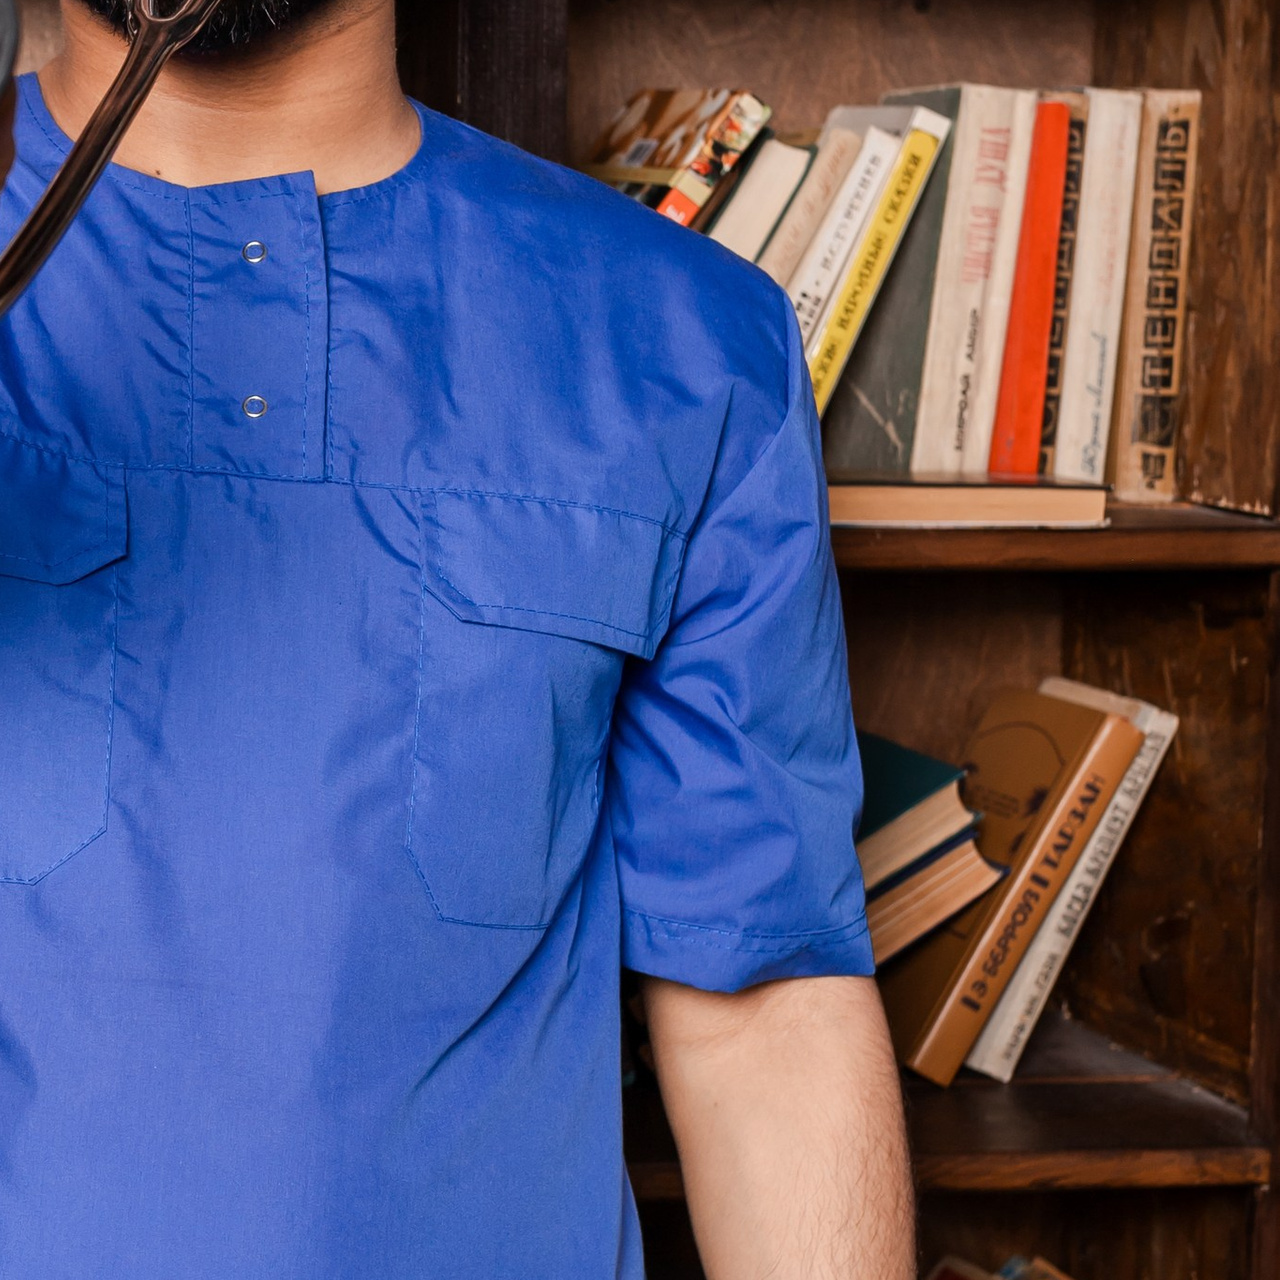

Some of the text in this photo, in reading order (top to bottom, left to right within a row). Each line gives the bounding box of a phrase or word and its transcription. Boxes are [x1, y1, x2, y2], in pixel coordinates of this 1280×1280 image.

[835, 230, 888, 330] НАРОДНЫЕ
[881, 153, 922, 225] СКАЗКИ
[955, 122, 1020, 287] ЧИСТАЯ ДУША
